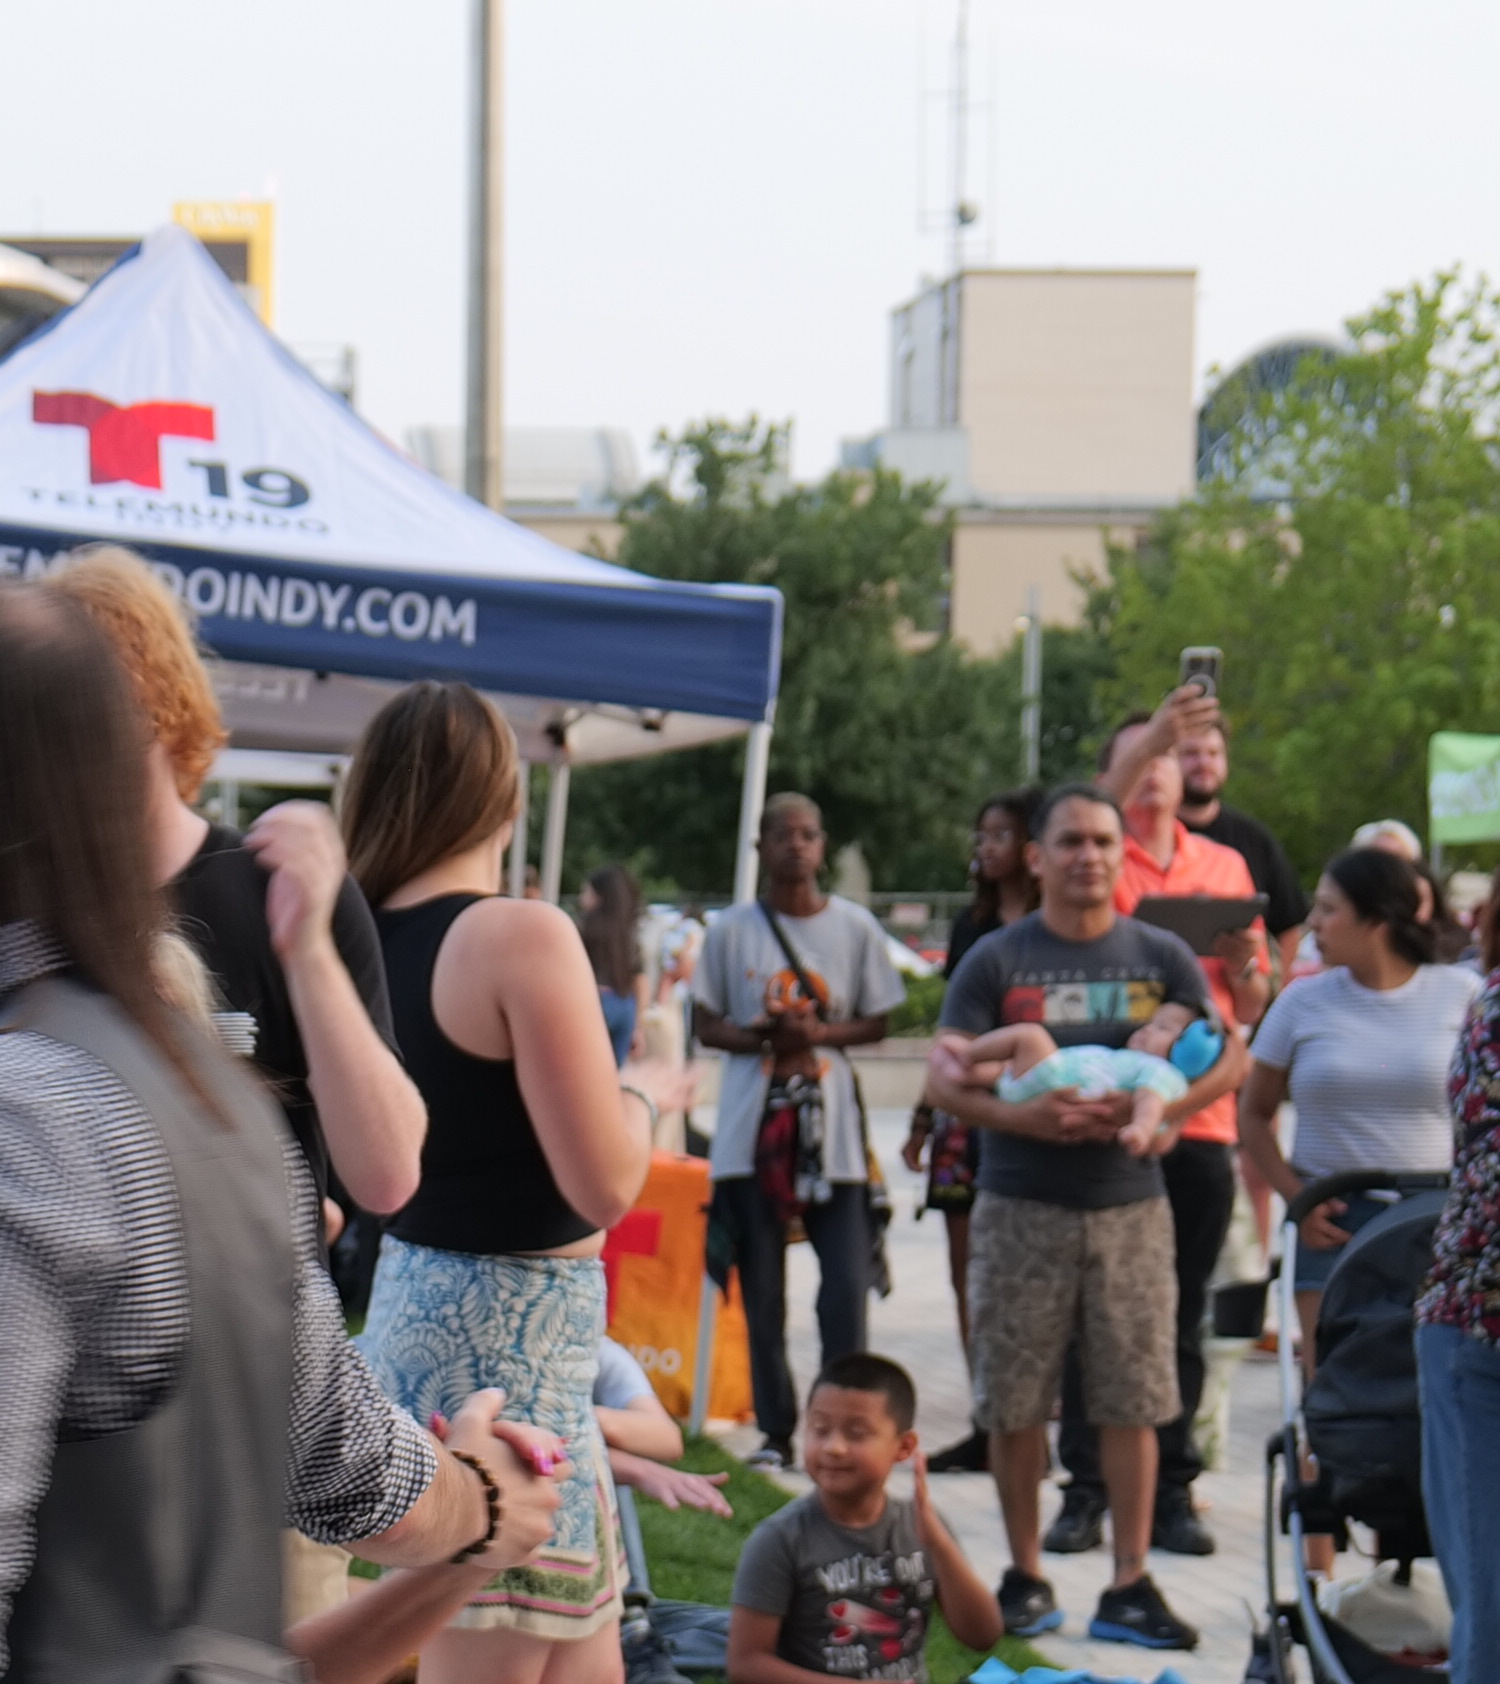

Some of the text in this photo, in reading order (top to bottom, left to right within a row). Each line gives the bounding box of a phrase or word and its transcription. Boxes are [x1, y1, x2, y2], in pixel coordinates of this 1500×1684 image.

[188, 459, 312, 509] 19
[23, 486, 329, 535] TELEMUNDO
[815, 1552, 892, 1592] YOU'RE
[823, 1645, 868, 1672] THIS
